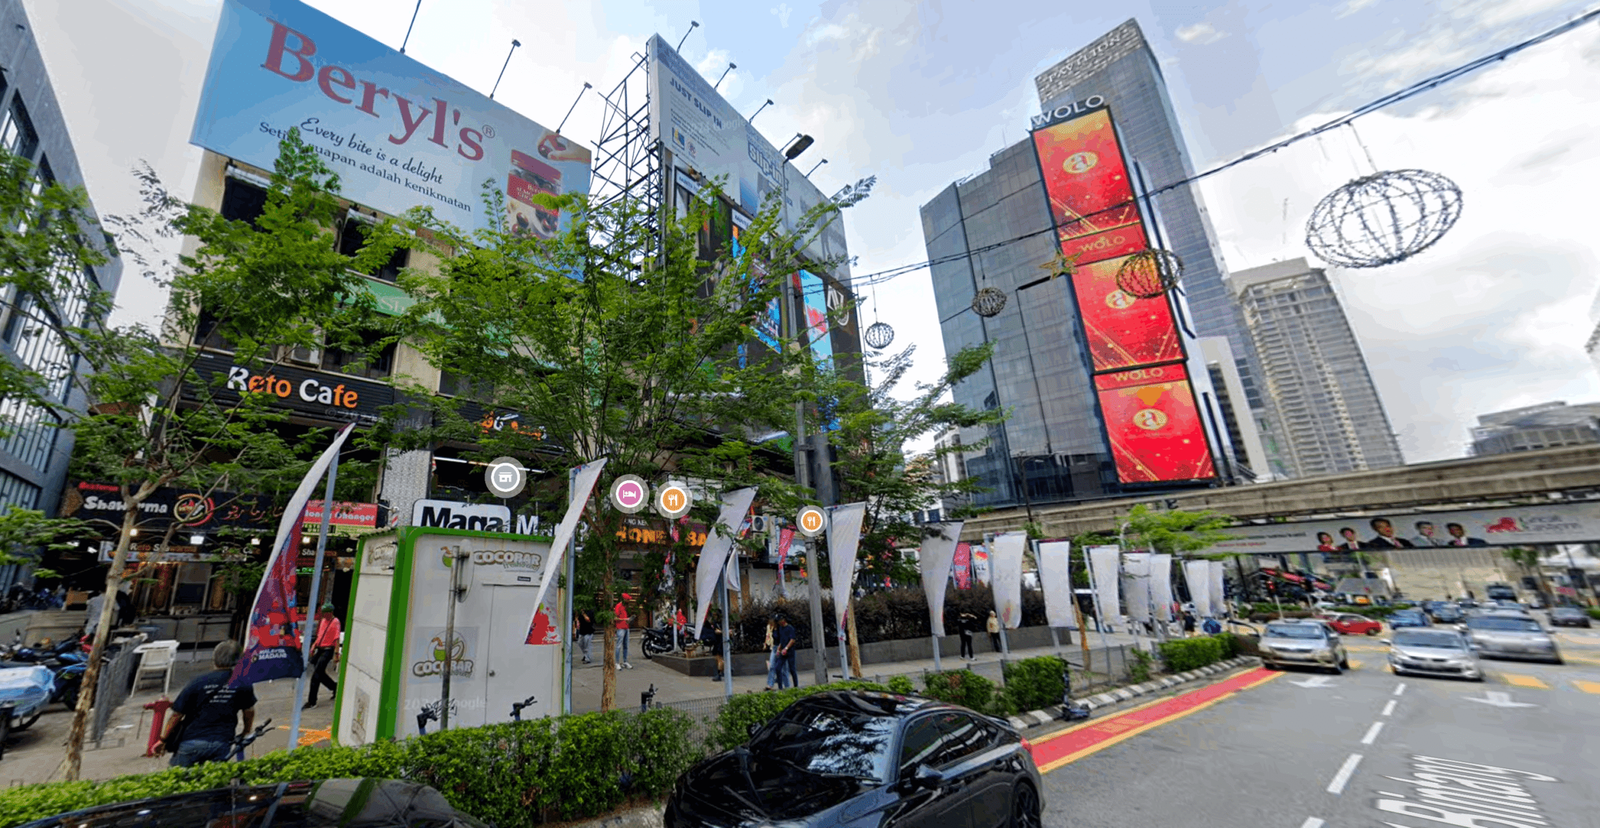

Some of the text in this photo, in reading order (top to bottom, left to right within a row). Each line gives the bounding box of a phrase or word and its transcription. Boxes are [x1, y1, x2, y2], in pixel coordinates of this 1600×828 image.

[669, 77, 723, 130] JUST SLIP IN
[1030, 95, 1104, 126] WOLO
[300, 118, 443, 185] Every bite is a delight
[360, 162, 401, 185] adalah
[405, 178, 472, 212] kenikmatan
[1077, 236, 1126, 252] WOLO
[227, 366, 358, 408] Reto Cafe
[1111, 368, 1163, 381] WOLO
[84, 496, 168, 513] Shawrma
[473, 550, 541, 567] COCOBAR
[413, 660, 473, 677] COCBAR
[1377, 754, 1560, 828] Bintang
